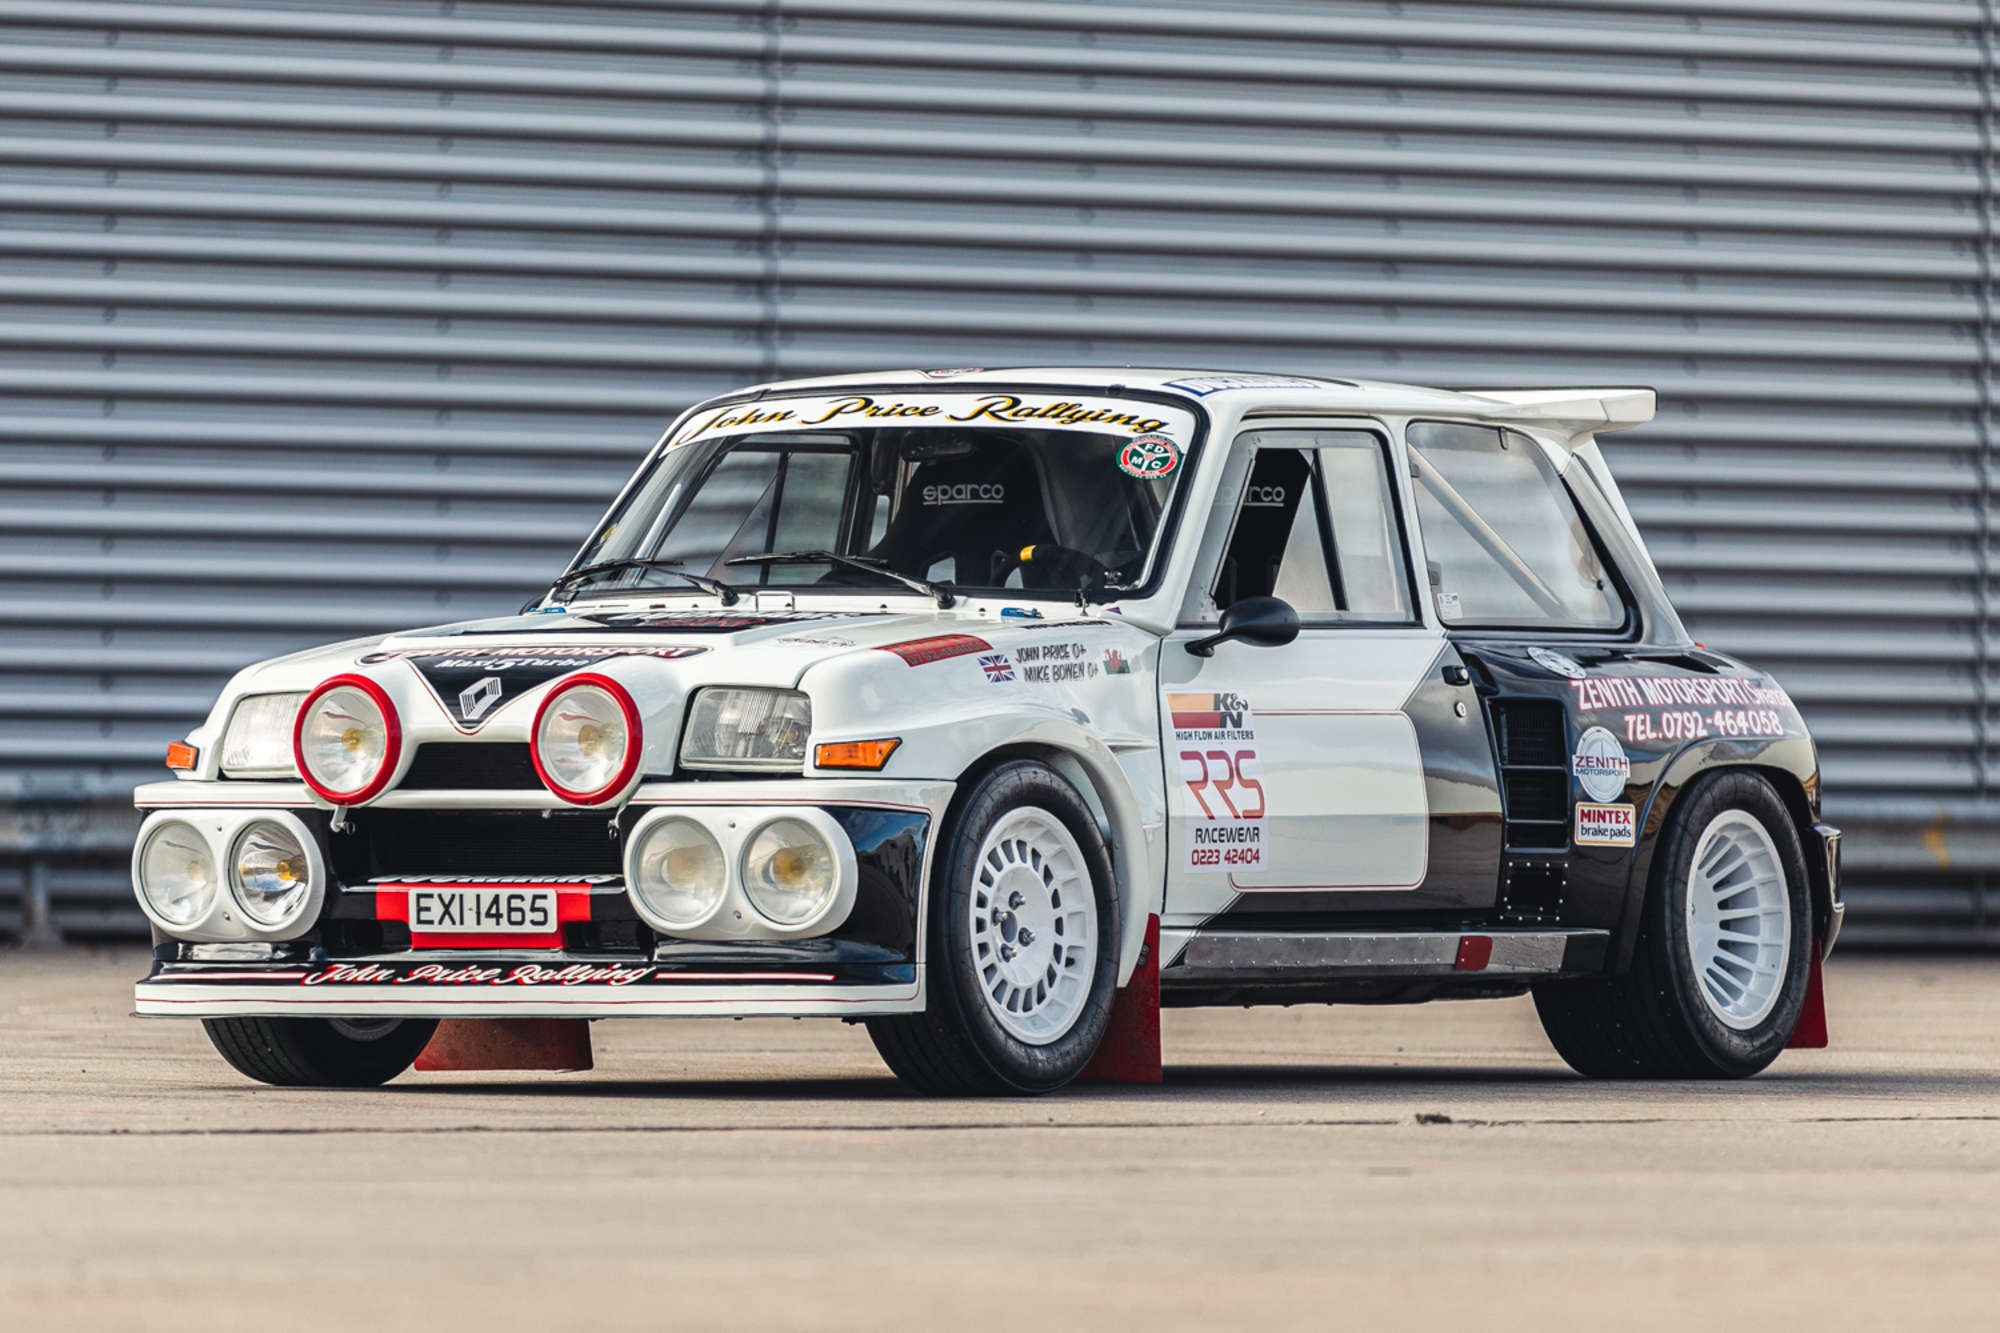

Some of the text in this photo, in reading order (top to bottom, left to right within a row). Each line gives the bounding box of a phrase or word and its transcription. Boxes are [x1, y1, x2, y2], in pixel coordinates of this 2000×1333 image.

[672, 396, 1174, 448] John Price Rallying
[922, 483, 1004, 506] sparco
[1015, 645, 1040, 664] JOHN
[1042, 643, 1070, 660] PRICE
[1023, 664, 1050, 682] MIKE
[1052, 662, 1085, 681] BOWEN
[1569, 678, 1645, 712] ZENITH
[1176, 730, 1255, 741] HIGH FLOW AIR FILTERS
[1575, 755, 1628, 769] ZENITH
[1575, 768, 1628, 777] MOTORSPORT
[1579, 809, 1631, 825] MINTEX
[1195, 827, 1260, 844] RACEWEAR
[1581, 824, 1632, 840] brake pads
[1191, 848, 1260, 866] 0223 42404
[302, 962, 657, 987] John Price Rallying
